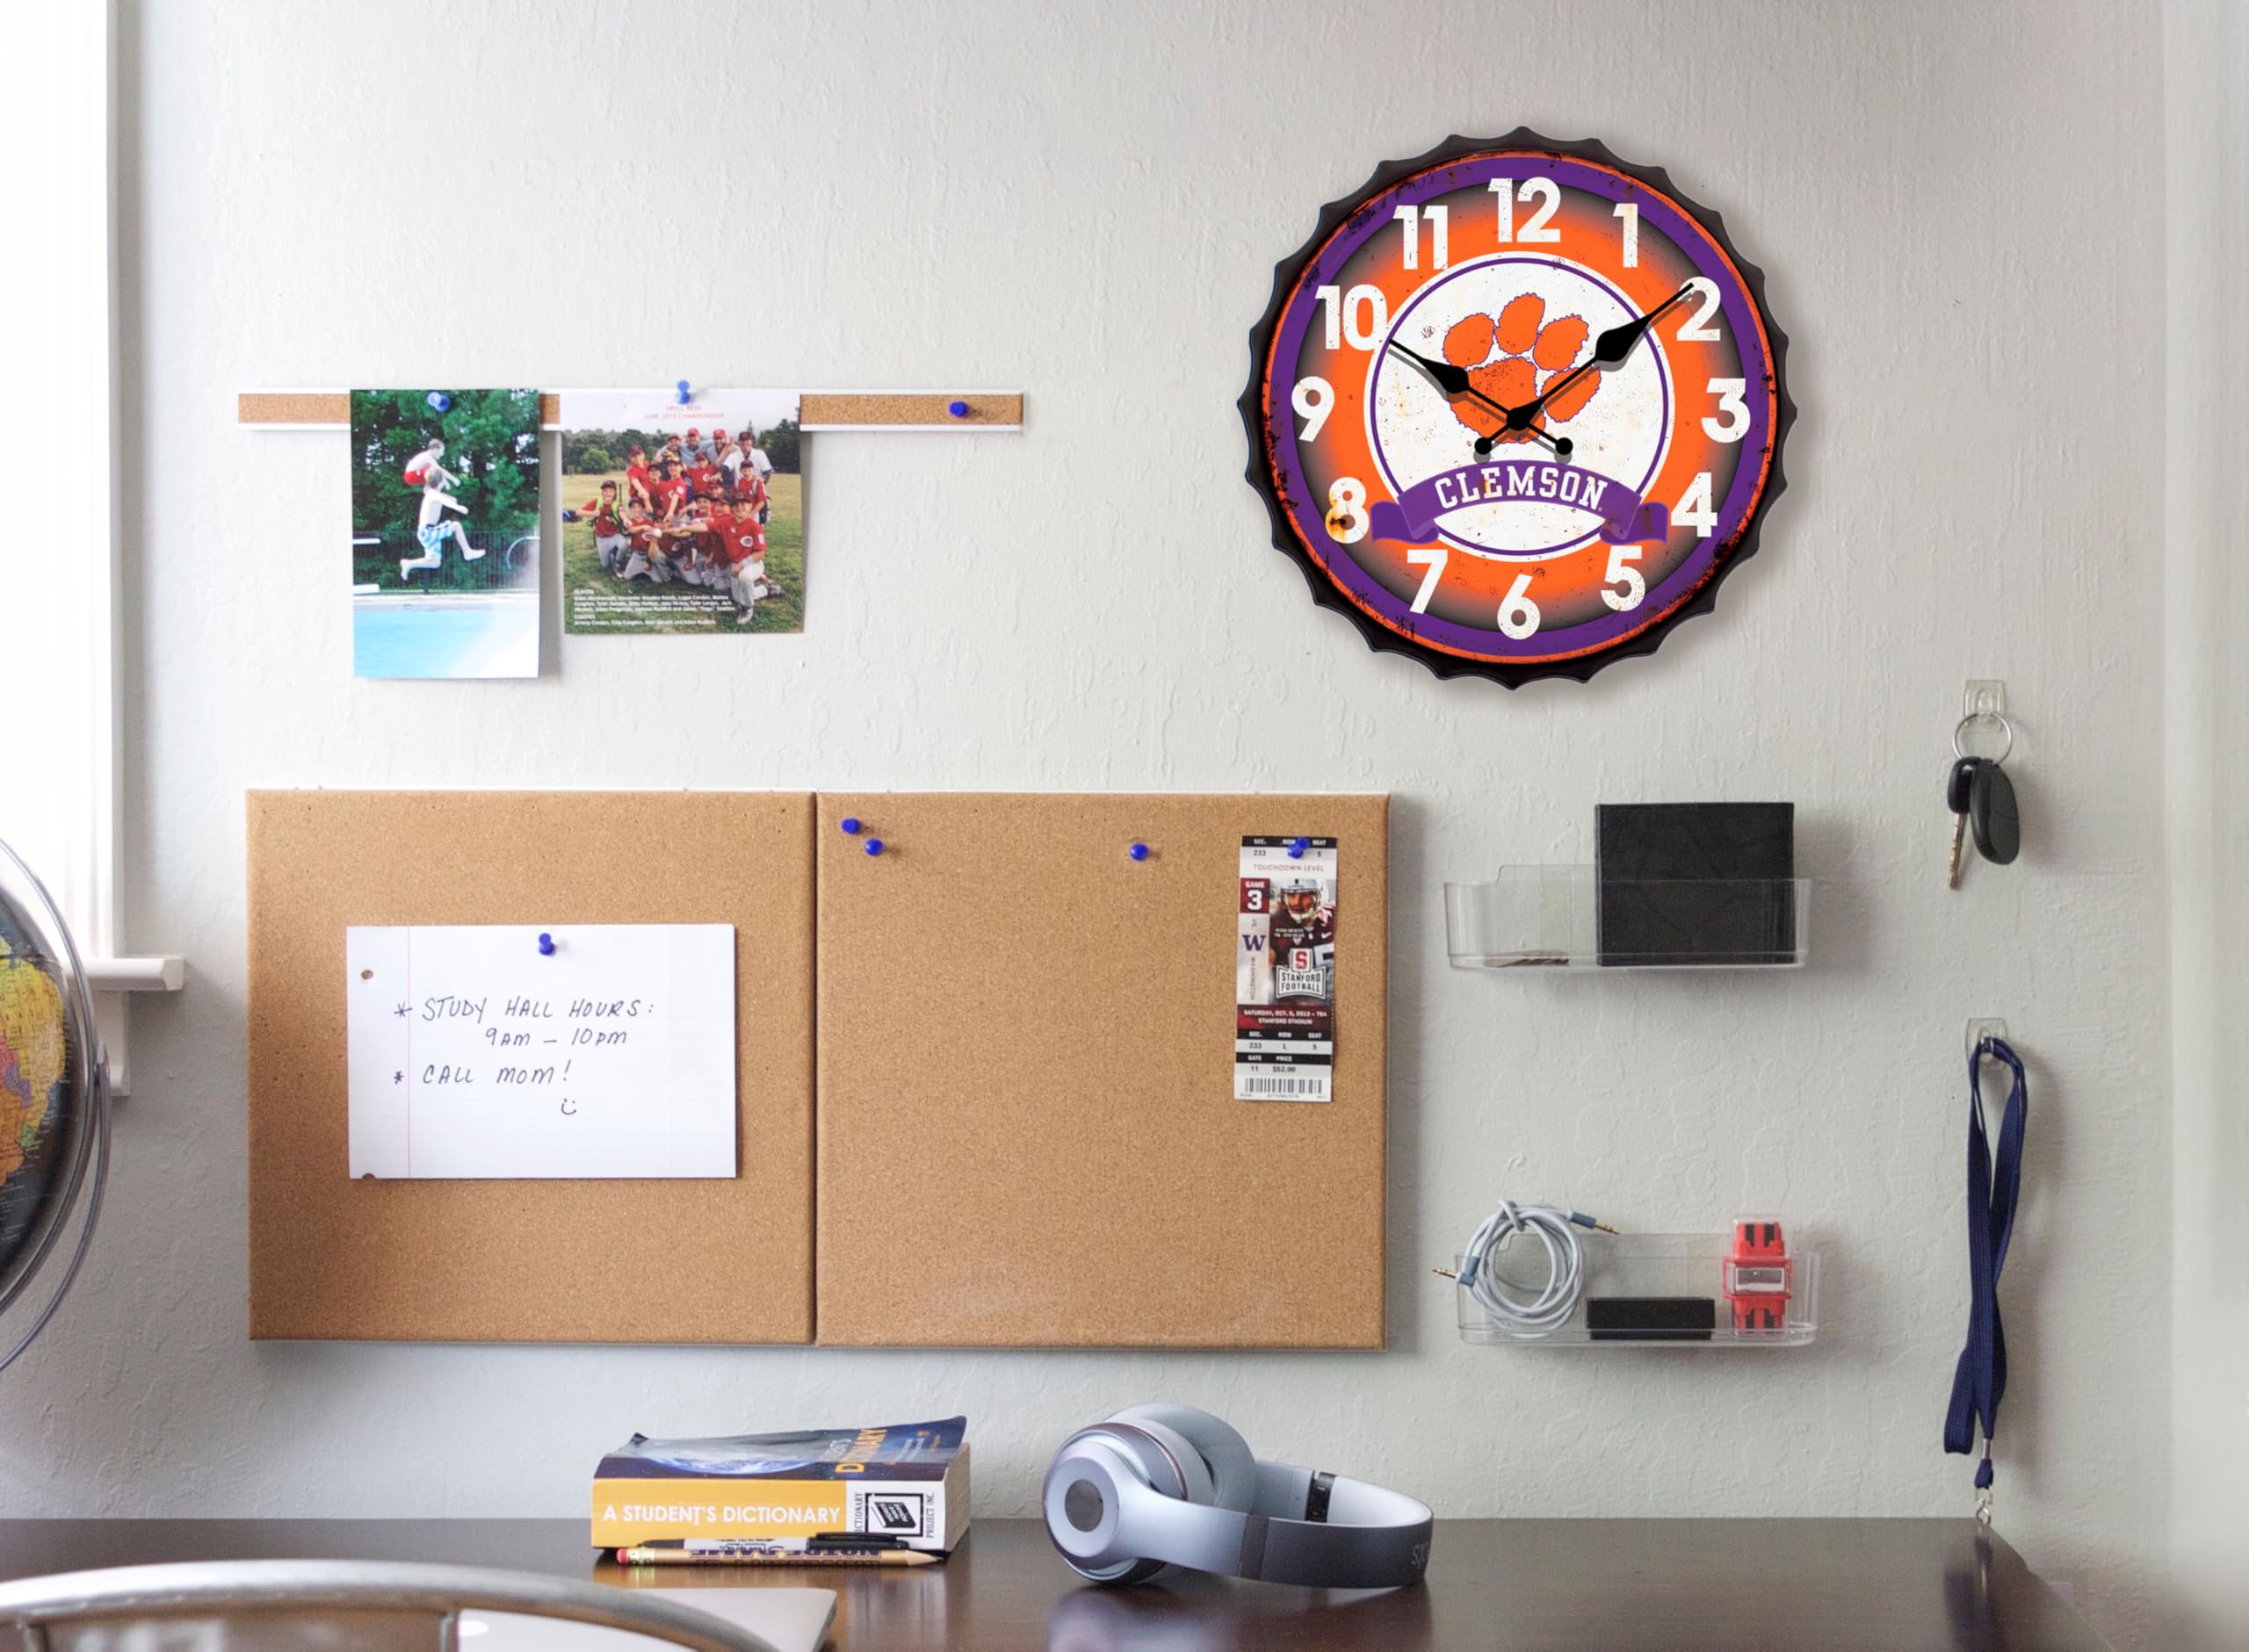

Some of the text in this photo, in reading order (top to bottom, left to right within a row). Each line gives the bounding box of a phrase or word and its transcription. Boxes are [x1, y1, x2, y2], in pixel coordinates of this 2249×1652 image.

[1392, 205, 1448, 270] 11
[1487, 177, 1561, 243] 12
[1613, 203, 1638, 268] 1
[1315, 284, 1387, 351] 10
[1676, 277, 1721, 342] 2
[1291, 376, 1335, 442] 9
[1701, 378, 1750, 444] 3
[1325, 477, 1369, 544] 8
[1435, 466, 1607, 510] CLEMSON
[1671, 473, 1717, 537] 4
[1406, 549, 1448, 614] 7
[1497, 574, 1540, 640] 6
[1601, 546, 1645, 611] 5
[1247, 890, 1262, 911] 3
[1242, 934, 1267, 951] W
[1295, 951, 1307, 970] S
[1281, 972, 1321, 982] STANFORD
[1281, 983, 1320, 993] FOOTBALL
[422, 996, 654, 1024] STUDY HALL HOURS:
[423, 1064, 474, 1084] CALL
[604, 1505, 841, 1526] A STUDENT'S DICTIONARY
[854, 1492, 864, 1533] ICTIONARY
[926, 1508, 935, 1539] PROJECT
